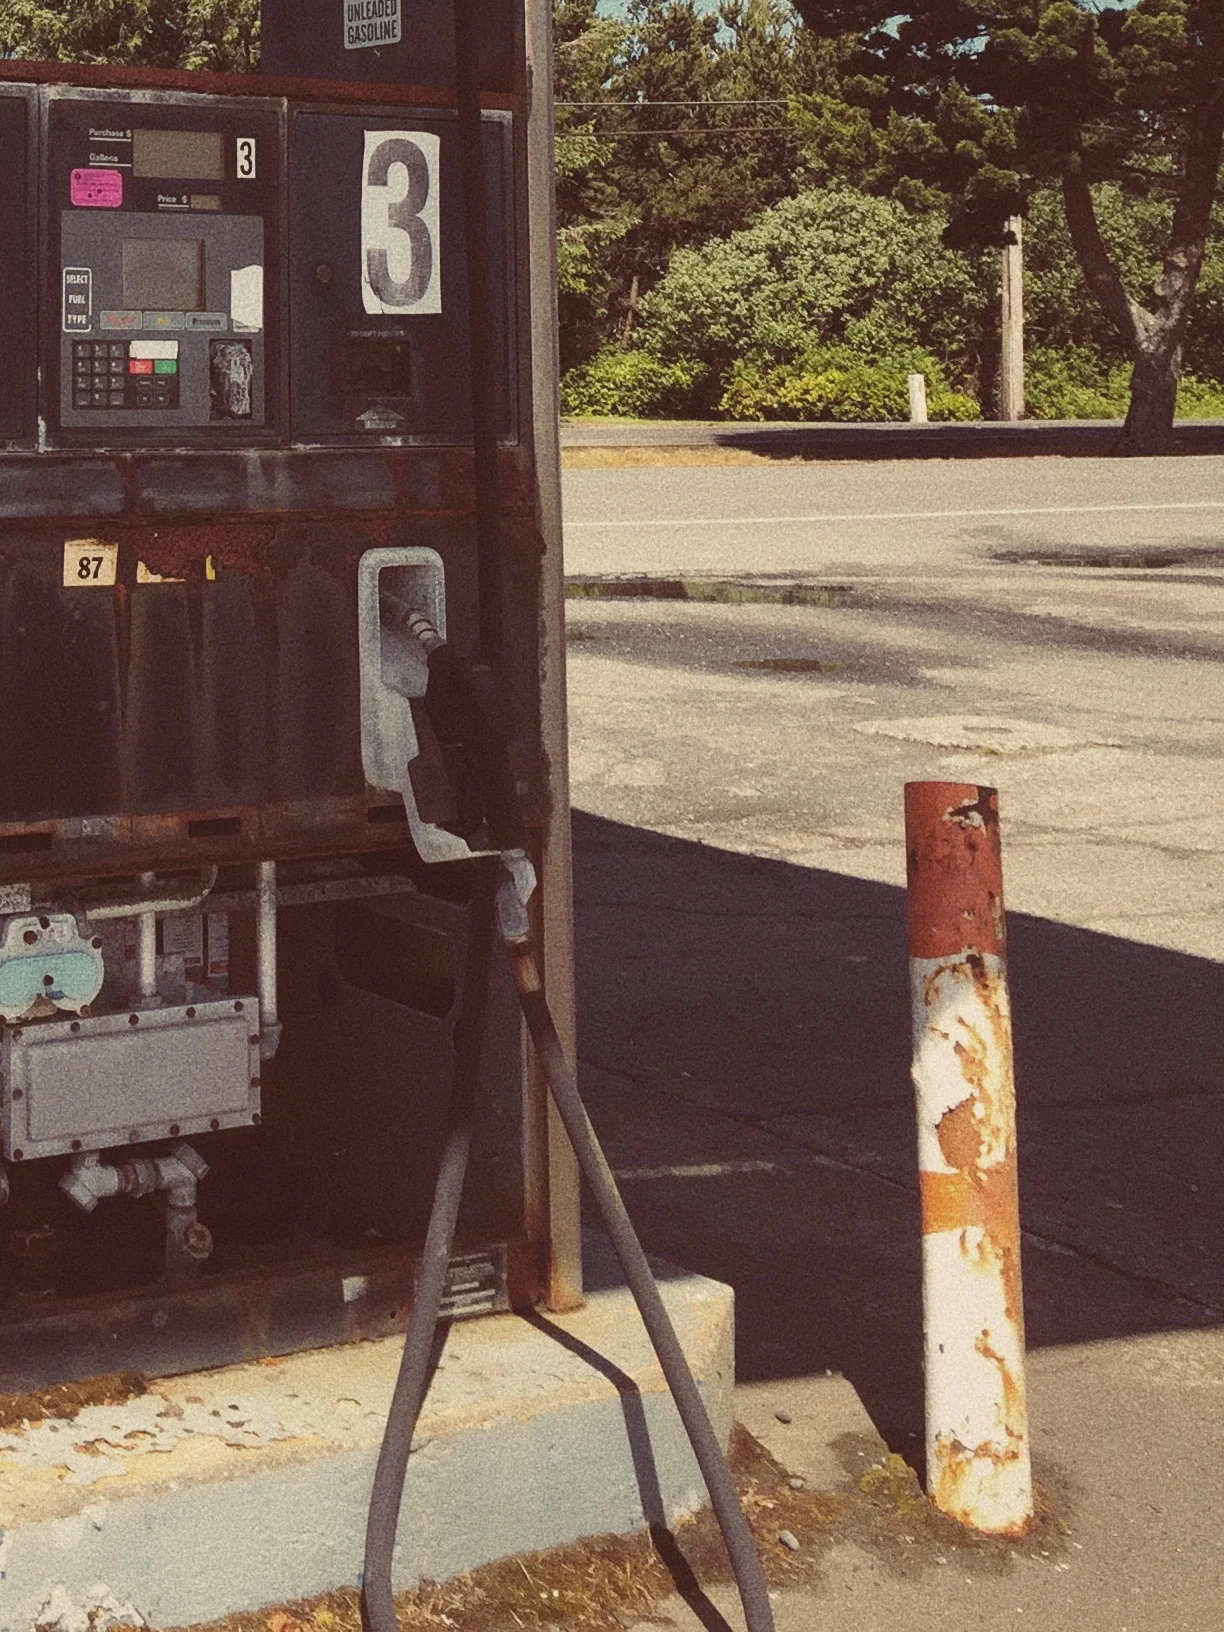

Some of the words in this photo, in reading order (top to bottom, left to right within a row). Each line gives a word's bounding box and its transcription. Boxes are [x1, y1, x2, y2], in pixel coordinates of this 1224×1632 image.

[347, 20, 397, 44] GASOLINE
[89, 128, 124, 137] Purchase
[240, 141, 252, 176] 3
[157, 194, 177, 203] Price
[366, 138, 433, 308] 3
[66, 274, 88, 284] SELECT
[68, 294, 86, 305] FUEL
[67, 314, 87, 325] TYPE
[77, 556, 104, 579] 87
